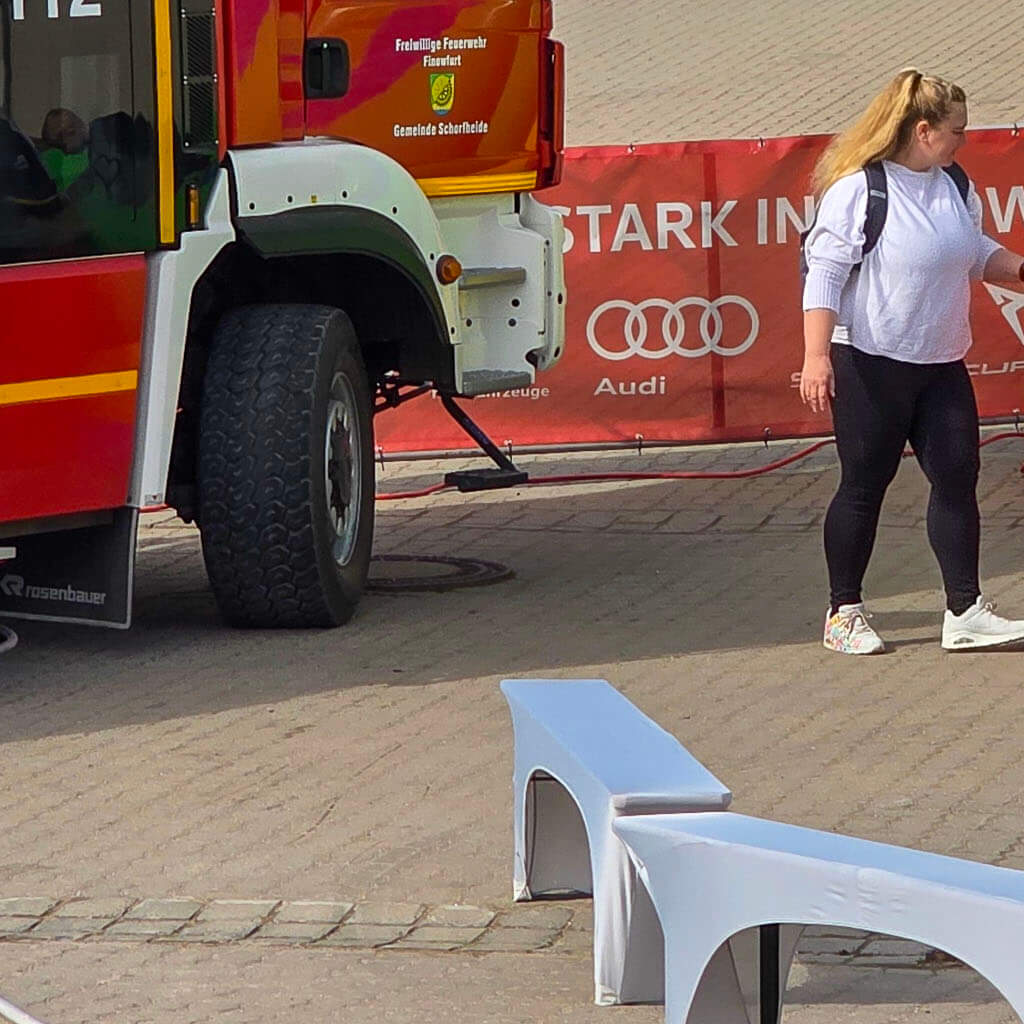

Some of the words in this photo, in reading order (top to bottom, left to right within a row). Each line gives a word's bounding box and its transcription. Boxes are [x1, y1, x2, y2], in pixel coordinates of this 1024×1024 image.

[395, 37, 441, 52] Freiwillige
[443, 36, 487, 50] Feuerwehr
[393, 124, 437, 137] Gemeinde
[438, 121, 488, 135] Schorfheide
[594, 376, 666, 396] Audi
[26, 584, 106, 604] rosenbauer
